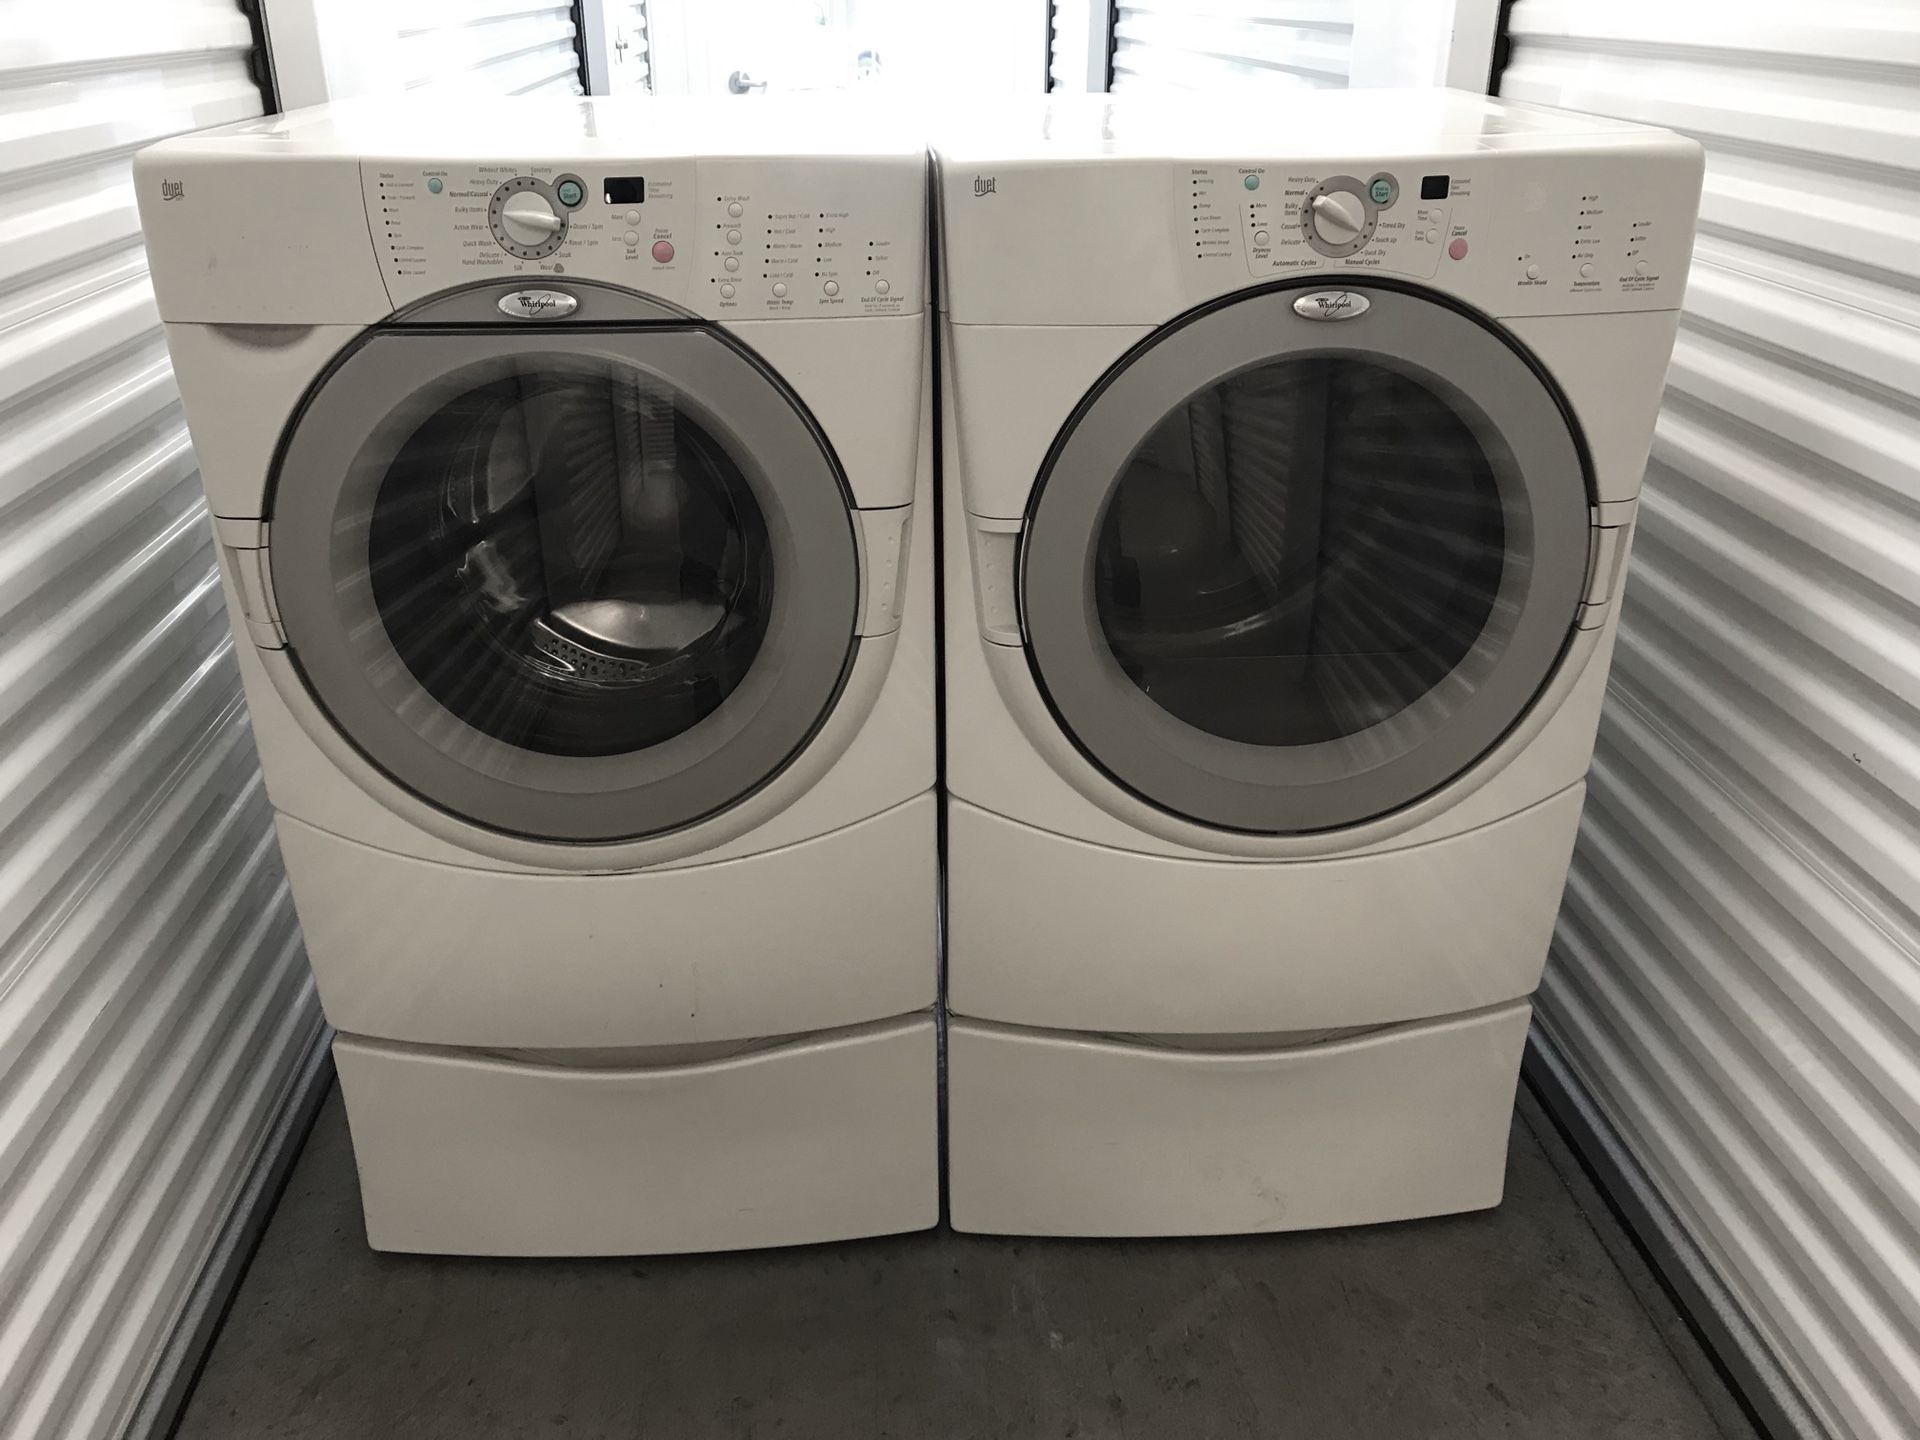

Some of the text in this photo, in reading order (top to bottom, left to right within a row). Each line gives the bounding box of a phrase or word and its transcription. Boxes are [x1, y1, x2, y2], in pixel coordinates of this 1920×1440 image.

[162, 178, 184, 199] duet
[974, 175, 997, 195] duet
[1285, 203, 1299, 211] Bulky
[1398, 221, 1406, 230] Dry
[1300, 259, 1317, 268] Cycles
[1365, 258, 1381, 266] Cycles
[520, 300, 556, 309] Whirlpool
[1318, 300, 1352, 310] Whirlpool
